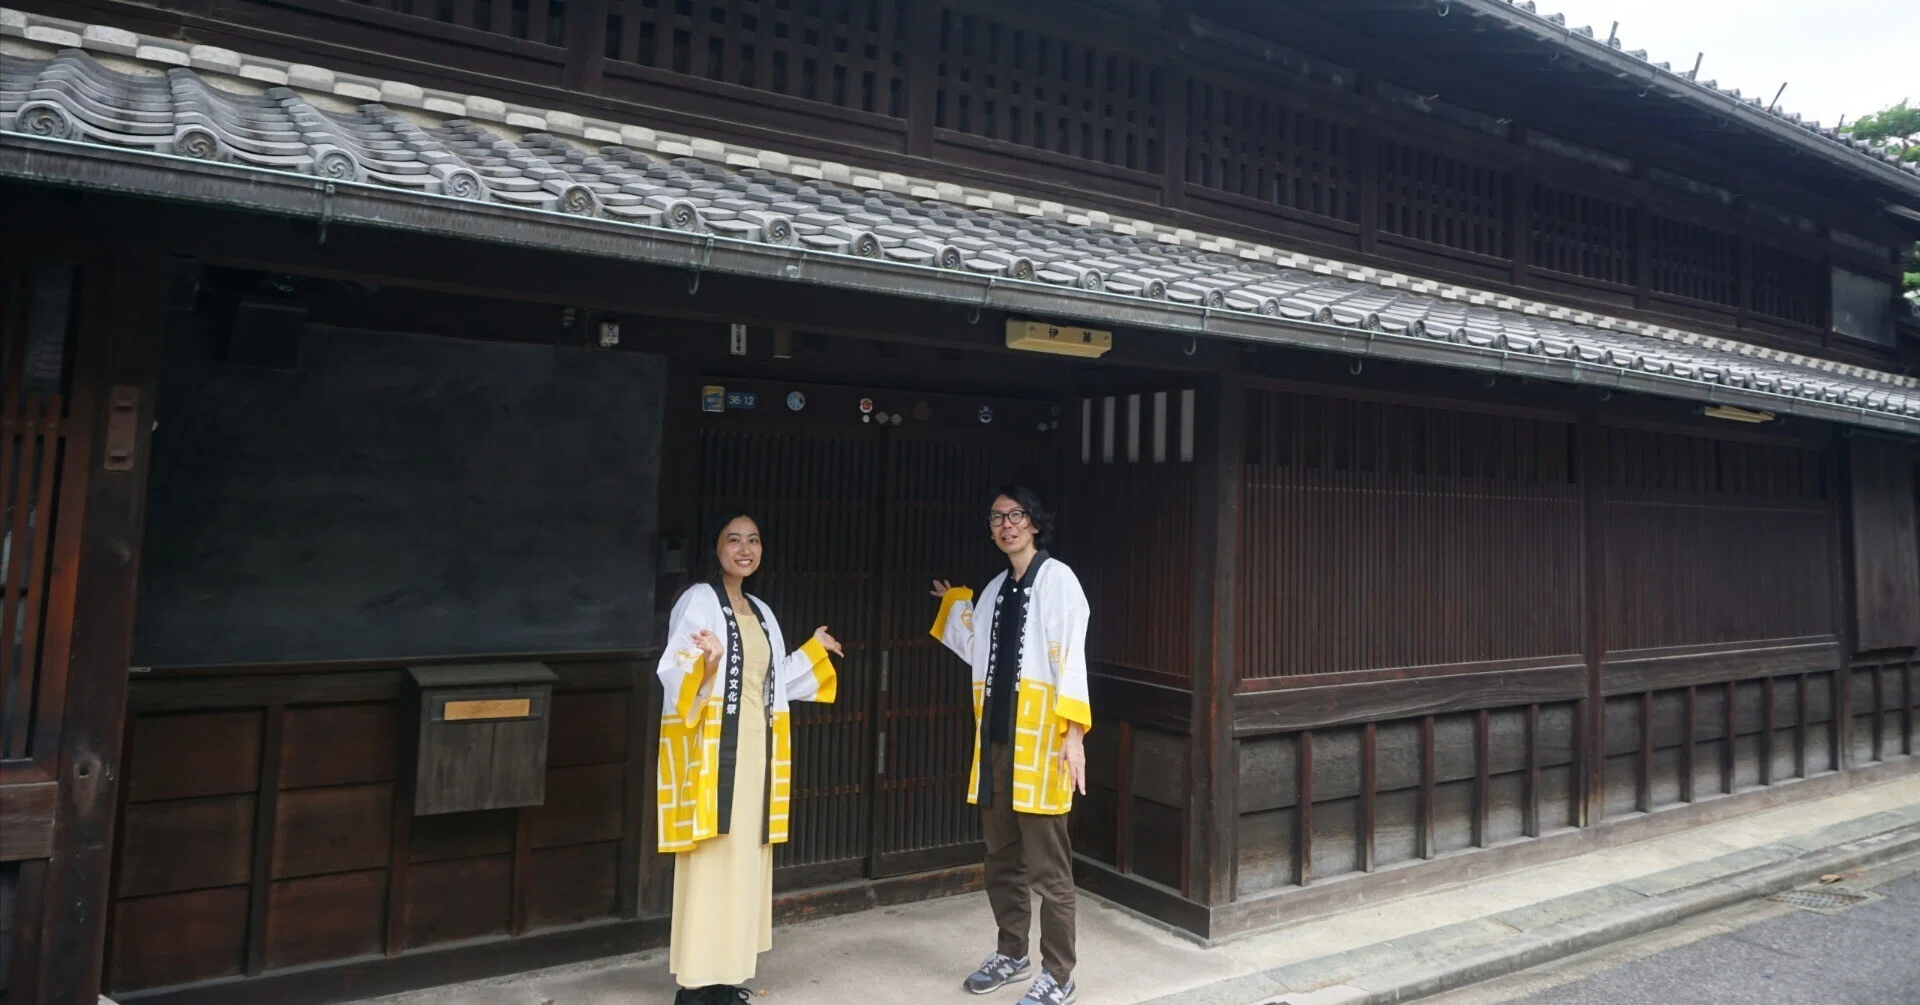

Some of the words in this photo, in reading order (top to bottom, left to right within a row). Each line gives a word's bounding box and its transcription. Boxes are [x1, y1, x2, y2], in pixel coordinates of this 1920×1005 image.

[726, 620, 741, 715] やっとかめ文化祭
